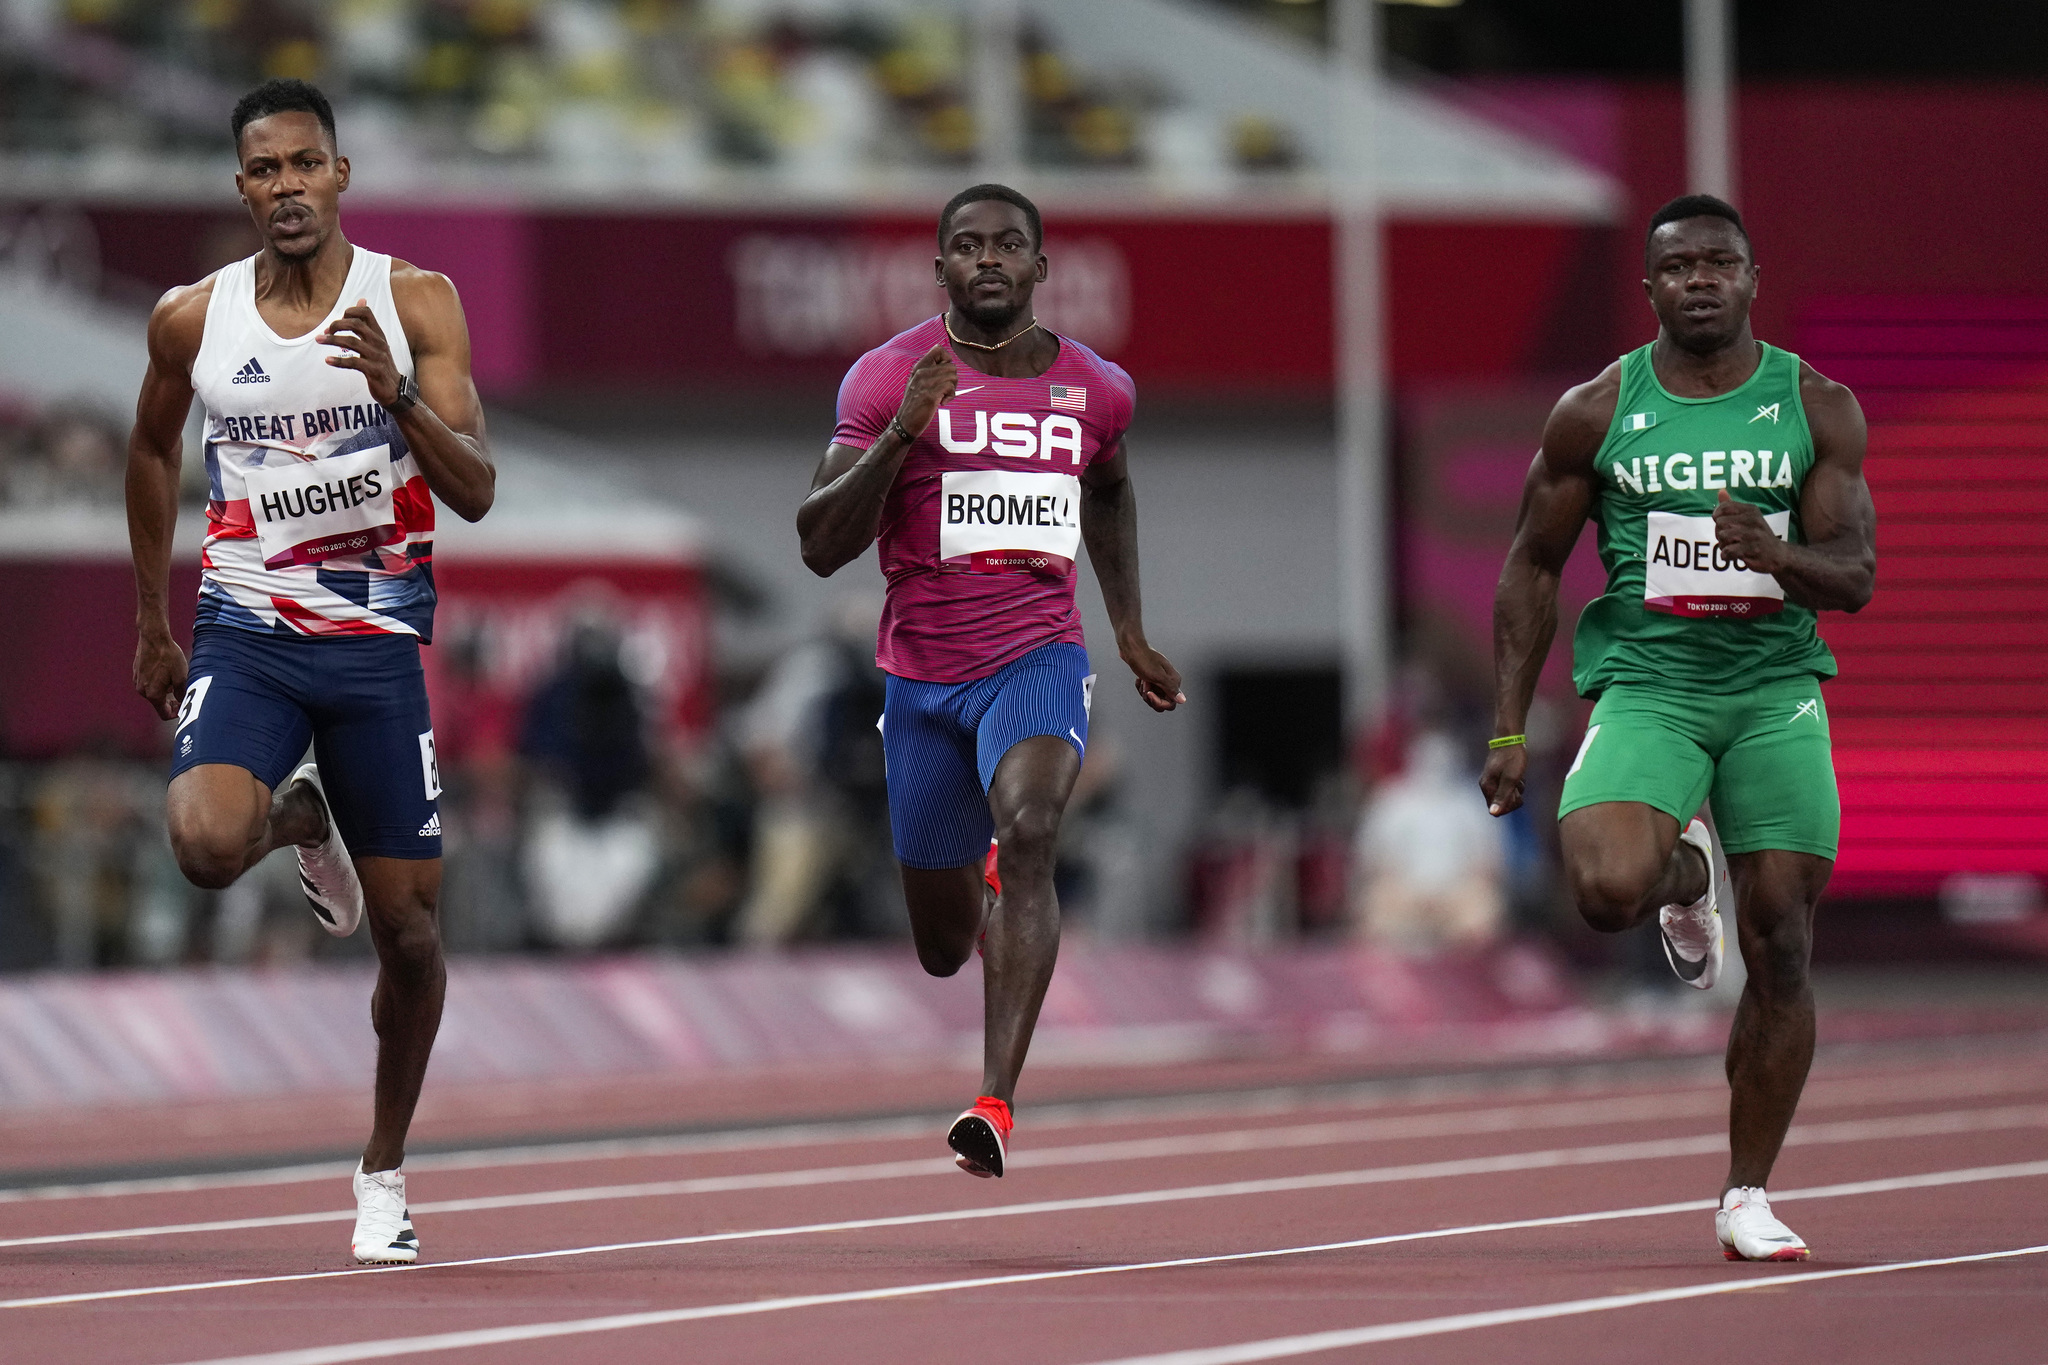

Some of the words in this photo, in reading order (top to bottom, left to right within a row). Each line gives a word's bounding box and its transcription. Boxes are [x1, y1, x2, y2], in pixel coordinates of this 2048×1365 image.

[232, 373, 271, 385] adidas
[225, 414, 296, 442] GREAT
[302, 403, 387, 438] BRITAIN
[938, 408, 1082, 465] USA
[1612, 450, 1793, 495] NIGERIA
[260, 469, 382, 523] HUGHES
[947, 494, 1076, 528] BROMELL
[307, 545, 330, 555] TOKYO
[330, 542, 347, 551] 2020
[985, 558, 1008, 566] TOKYO
[1687, 602, 1710, 611] TOKYO
[1710, 603, 1728, 611] 2020
[418, 827, 441, 837] adida
